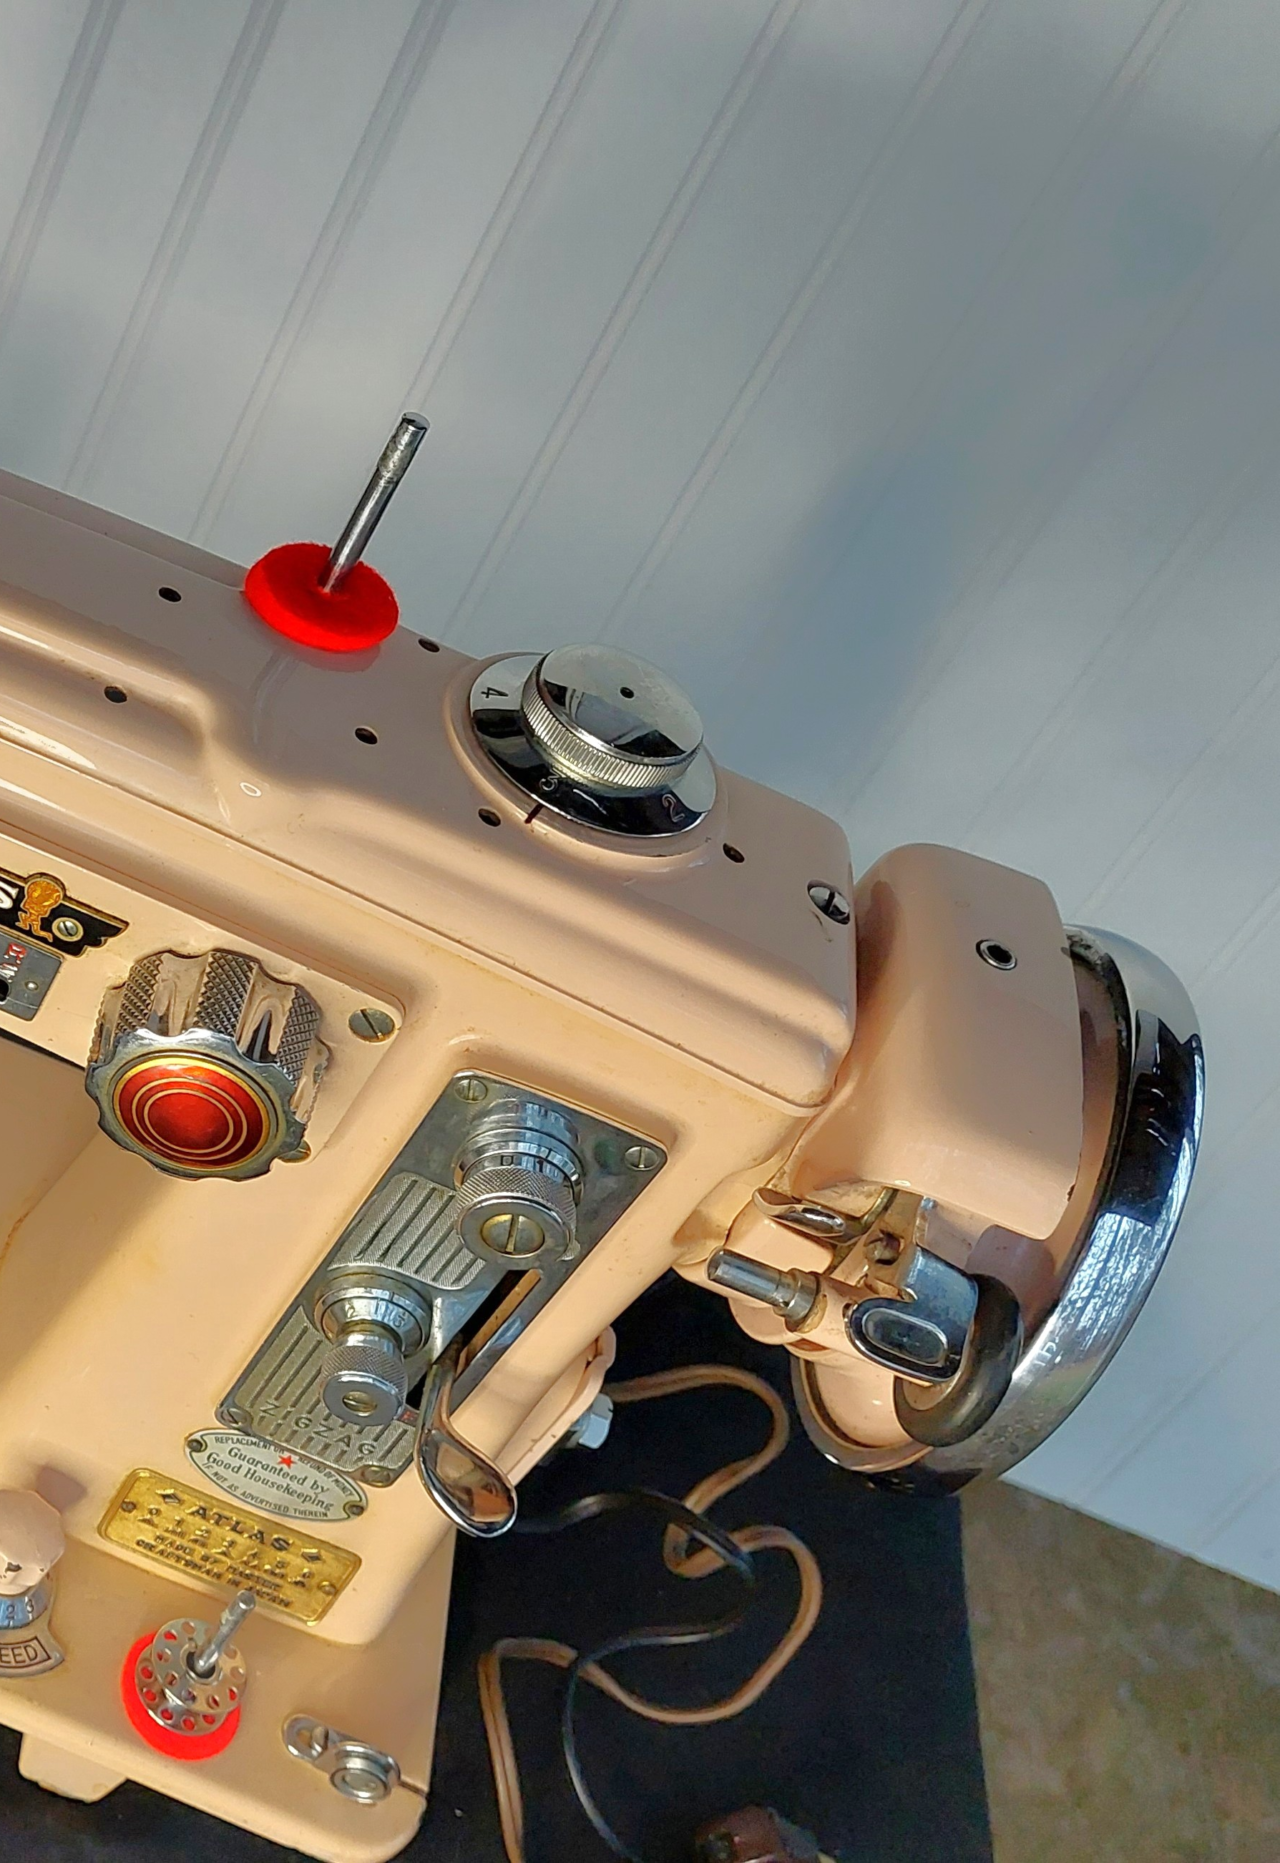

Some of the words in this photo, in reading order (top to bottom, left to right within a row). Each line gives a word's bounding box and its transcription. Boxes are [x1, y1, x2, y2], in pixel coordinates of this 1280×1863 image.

[481, 686, 508, 699] 4
[662, 793, 685, 823] 2
[214, 1436, 271, 1451] REPLACEMENT
[206, 1451, 243, 1475] Good
[244, 1466, 335, 1513] Housekeeping
[228, 1446, 311, 1488] Guaranteed
[310, 1479, 330, 1495] by
[211, 1470, 229, 1484] NOT
[227, 1483, 240, 1494] AS
[240, 1489, 290, 1514] ADVERTISED
[293, 1507, 329, 1518] THEREIN
[185, 1502, 293, 1552] ATLAS
[6, 1605, 15, 1619] 2
